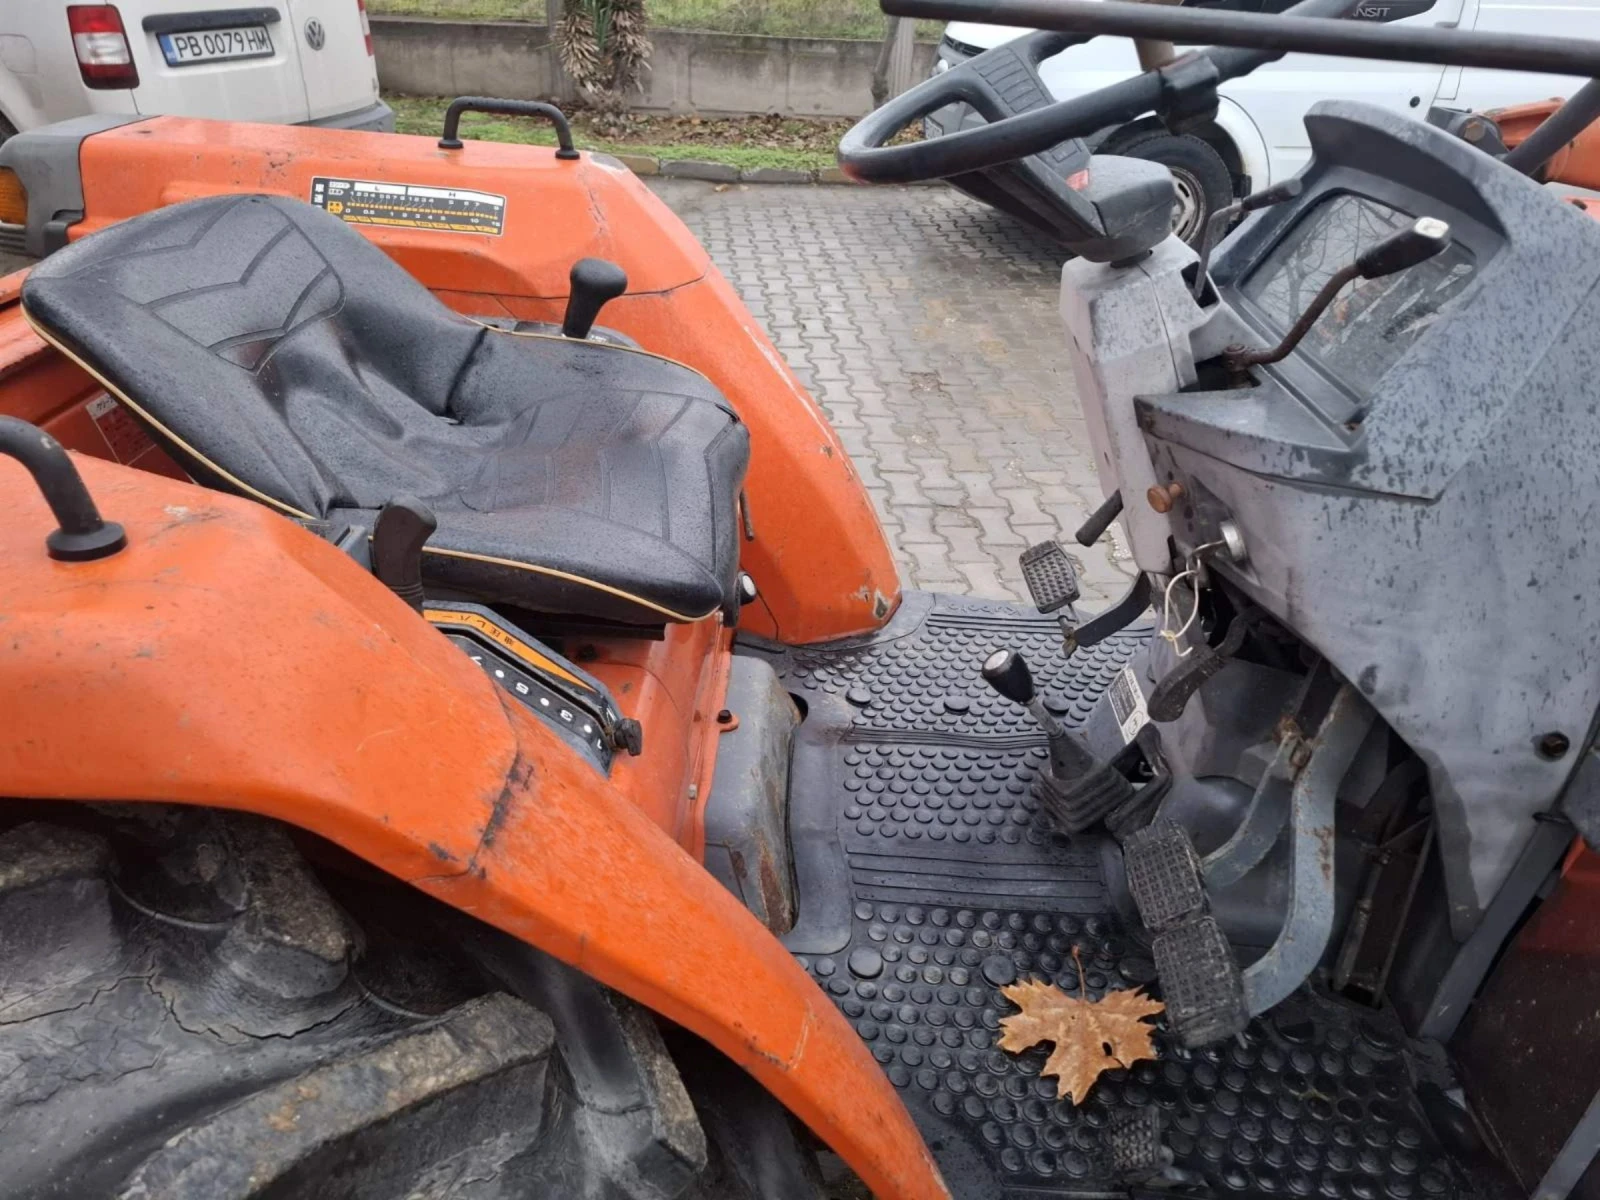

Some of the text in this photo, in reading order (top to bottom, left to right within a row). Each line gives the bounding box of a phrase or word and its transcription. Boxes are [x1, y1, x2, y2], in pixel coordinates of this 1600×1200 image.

[174, 35, 203, 58] PB
[203, 32, 244, 55] 0079
[516, 682, 529, 695] 5
[560, 709, 573, 722] 3
